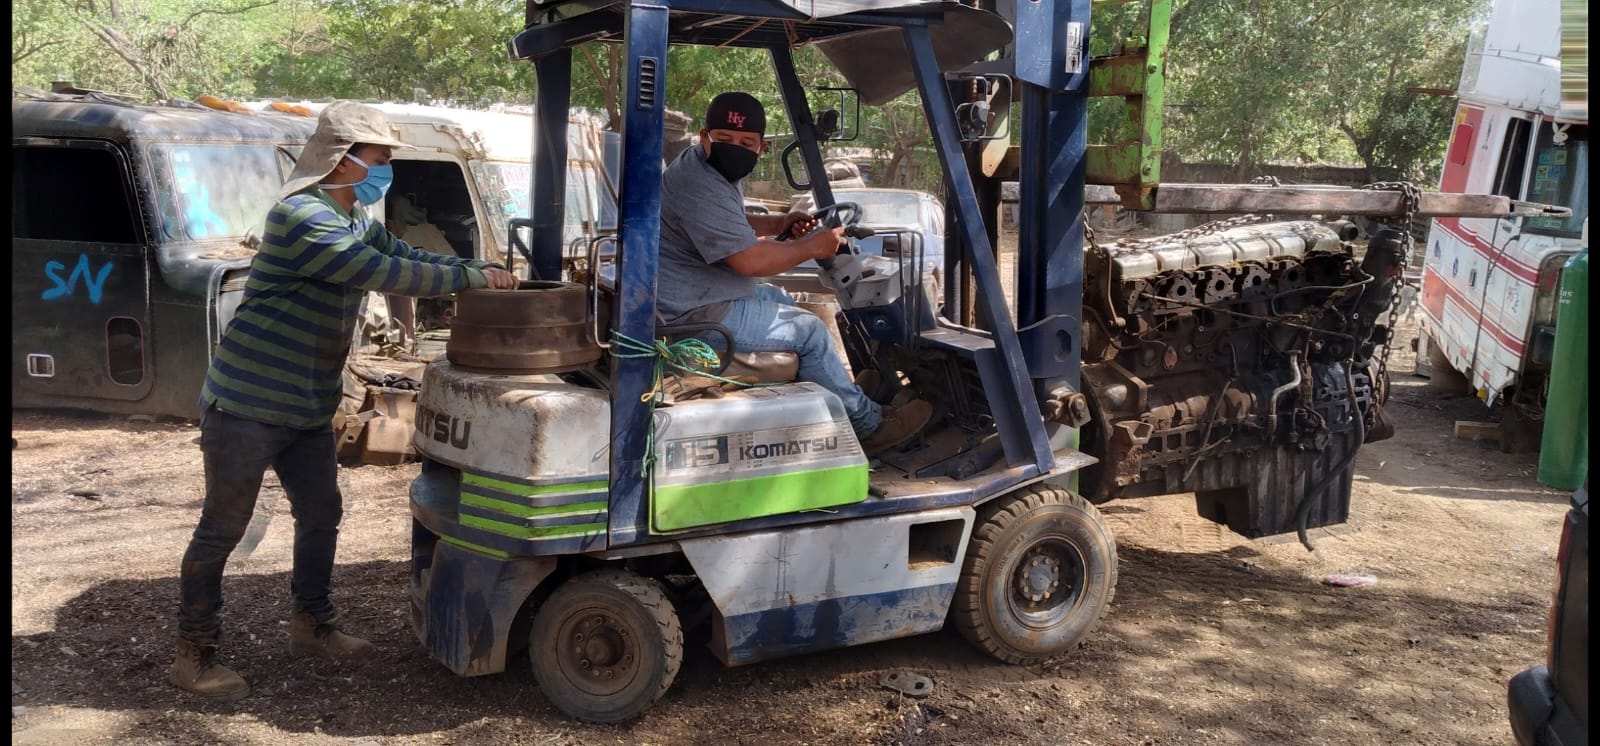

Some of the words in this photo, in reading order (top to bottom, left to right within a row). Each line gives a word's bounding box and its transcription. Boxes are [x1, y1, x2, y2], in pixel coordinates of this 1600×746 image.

[728, 111, 747, 128] NY
[41, 253, 114, 304] SN
[682, 439, 721, 468] 15
[739, 436, 838, 461] KOMATSU
